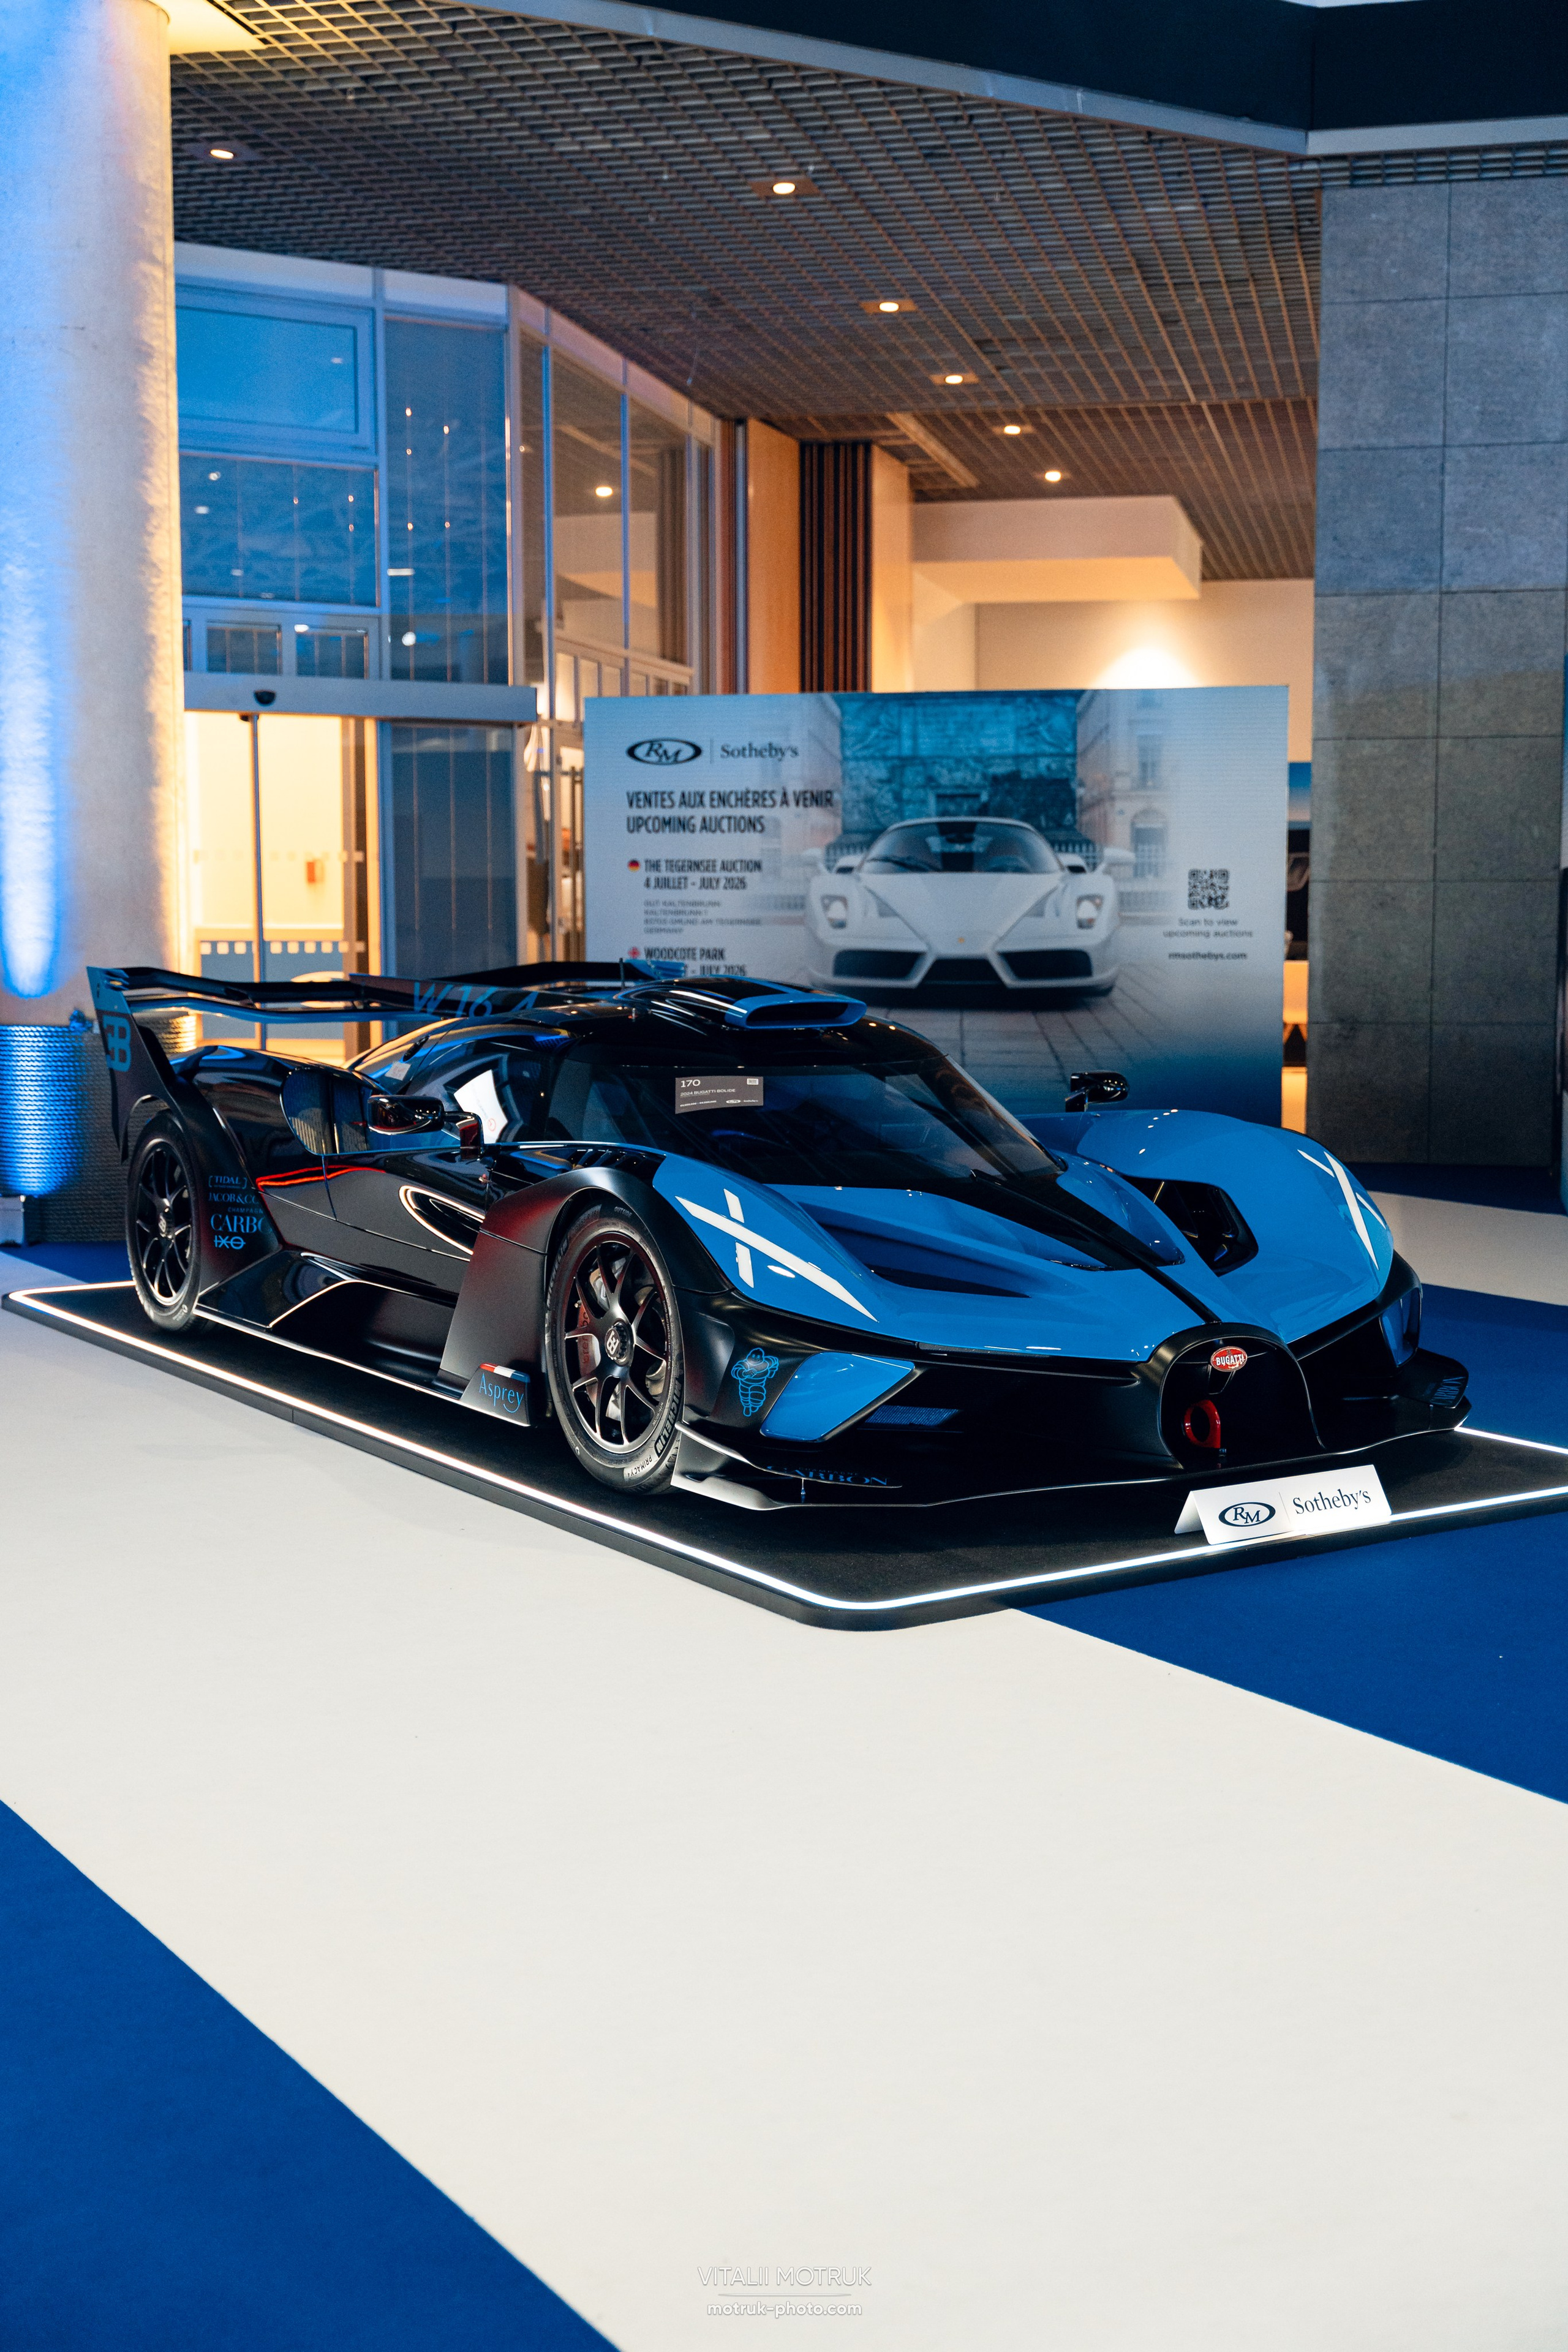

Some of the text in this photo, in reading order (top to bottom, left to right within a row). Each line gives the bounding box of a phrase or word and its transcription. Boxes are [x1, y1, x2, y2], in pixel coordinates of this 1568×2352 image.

[720, 741, 799, 762] Sotheby's
[626, 785, 835, 809] VENTES AUX ENCHÈRES À VENIR
[626, 815, 765, 834] UPCOMING AUCTIONS
[644, 859, 763, 873] THE TEGERNSEE AUCTION
[644, 876, 650, 889] 4
[654, 876, 688, 889] JUILLET
[698, 876, 720, 889] JULY
[723, 876, 748, 889] 2026
[1178, 918, 1238, 926] Scan to view
[1163, 930, 1210, 939] upcoming
[644, 947, 725, 961] WOODCOTE PARK
[1169, 951, 1248, 961] rmsothebys.com
[699, 963, 720, 976] JULY
[680, 1079, 701, 1088] 170
[214, 1175, 241, 1185] TIDAL
[614, 1206, 633, 1218] OUTSIDE
[1216, 1353, 1245, 1366] BUGATTI
[479, 1373, 524, 1414] Asprey
[656, 1379, 682, 1455] MICHELIN
[630, 1455, 652, 1477] PRIMACY
[1232, 1488, 1371, 1525] RM Sotheby's
